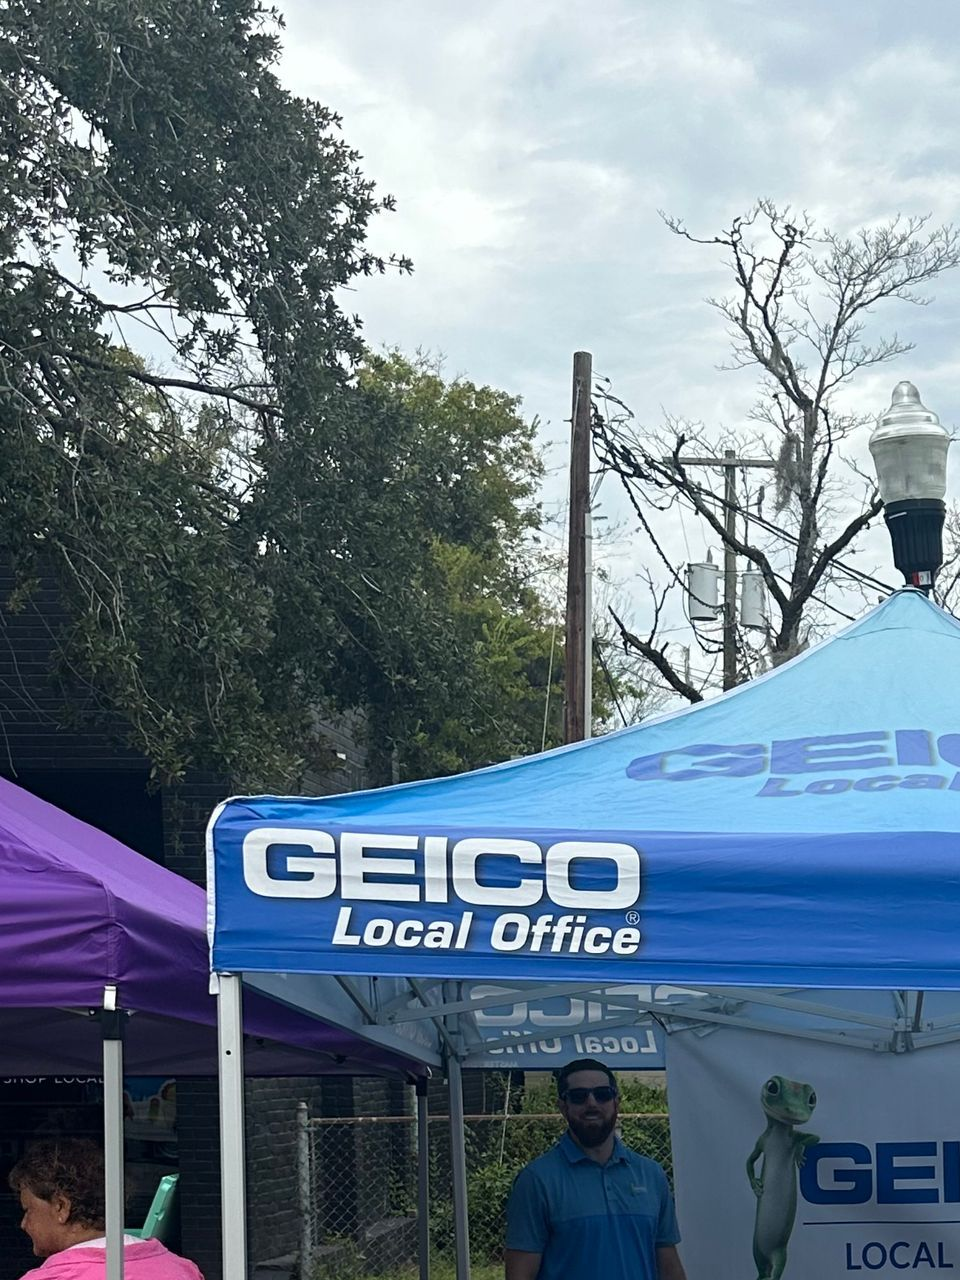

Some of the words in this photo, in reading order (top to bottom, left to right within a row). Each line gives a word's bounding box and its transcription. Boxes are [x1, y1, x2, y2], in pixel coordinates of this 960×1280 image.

[242, 827, 640, 910] GEICO
[331, 906, 473, 951] Local
[490, 913, 641, 955] Office
[845, 1241, 954, 1270] LOCAL
